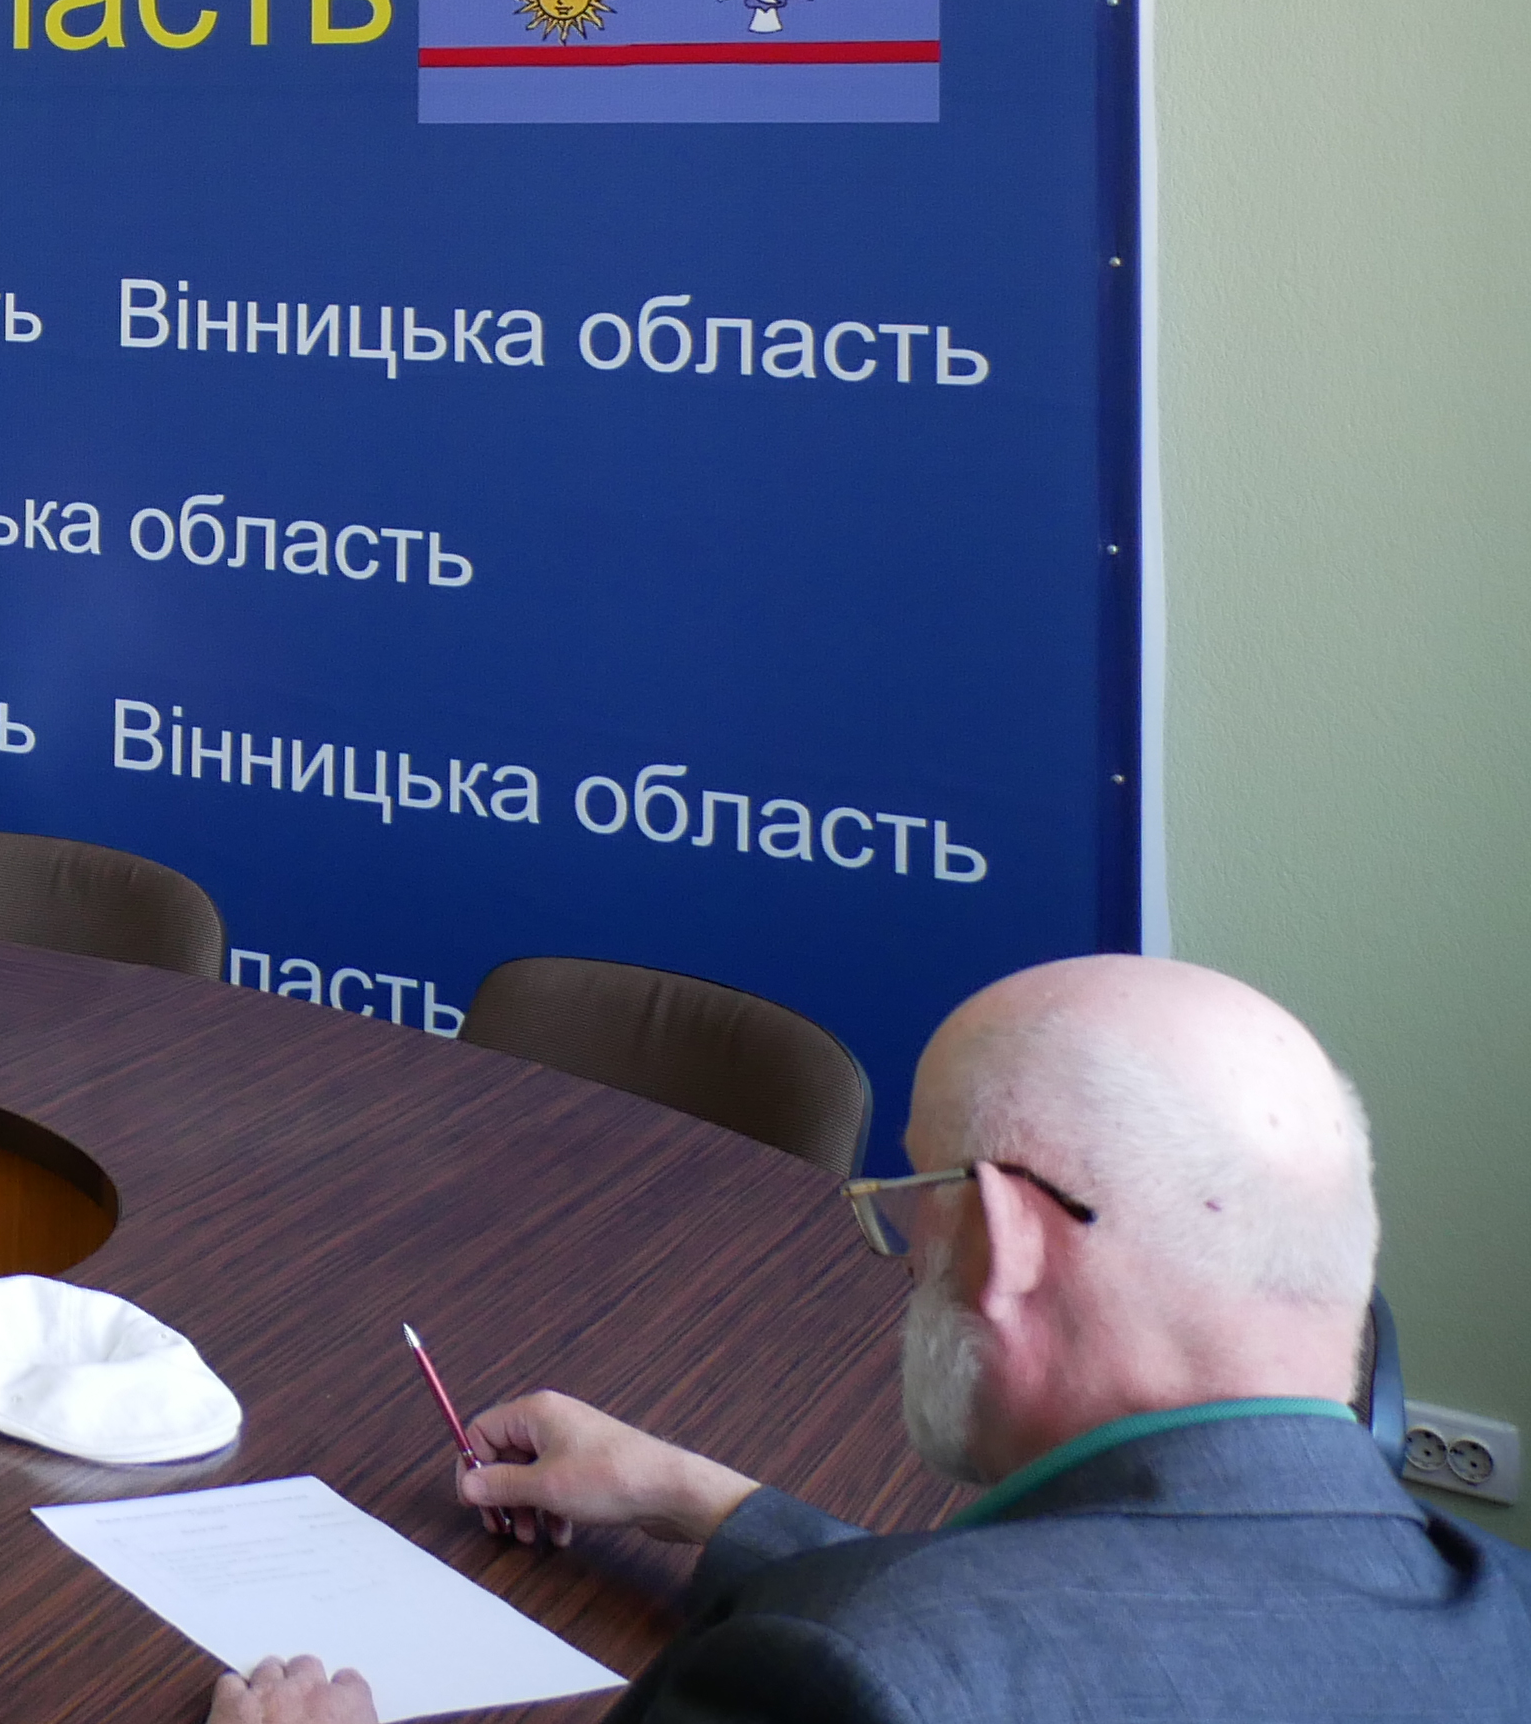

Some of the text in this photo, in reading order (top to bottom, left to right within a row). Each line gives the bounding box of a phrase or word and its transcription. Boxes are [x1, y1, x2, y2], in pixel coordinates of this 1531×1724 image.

[120, 278, 990, 386] Вінницька область
[129, 494, 473, 587] область
[114, 698, 987, 882] Вінницька область
[229, 947, 466, 1039] ласть
